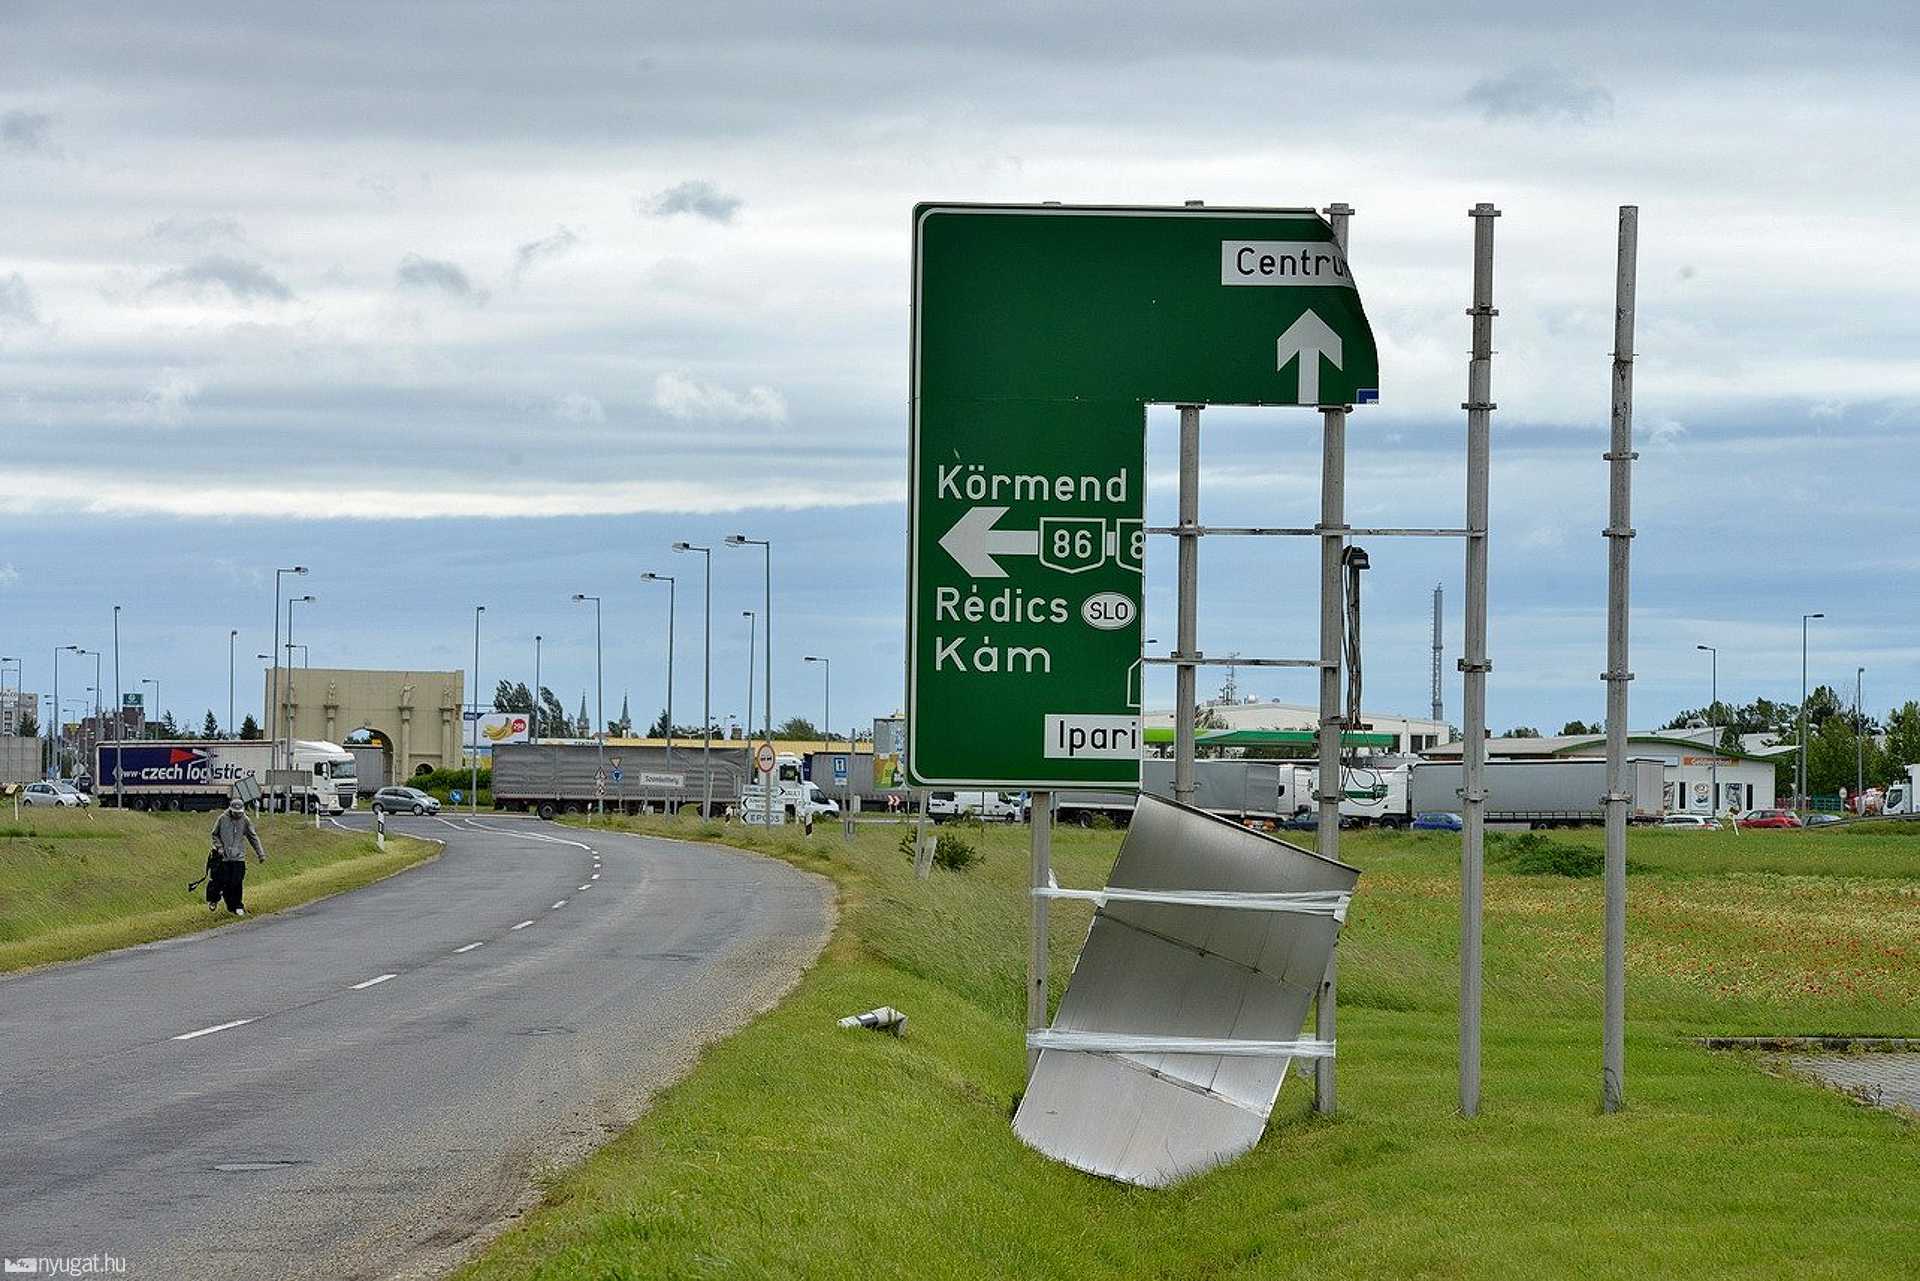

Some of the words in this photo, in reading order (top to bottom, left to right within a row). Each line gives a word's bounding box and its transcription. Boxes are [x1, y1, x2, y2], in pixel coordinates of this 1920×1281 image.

[1237, 247, 1348, 277] Centru
[937, 463, 1127, 502] Körmend
[1053, 529, 1092, 559] 86
[935, 584, 1069, 623] Rédics
[1089, 602, 1129, 620] SLO
[935, 636, 1051, 673] Kám
[1059, 720, 1137, 757] Ipari
